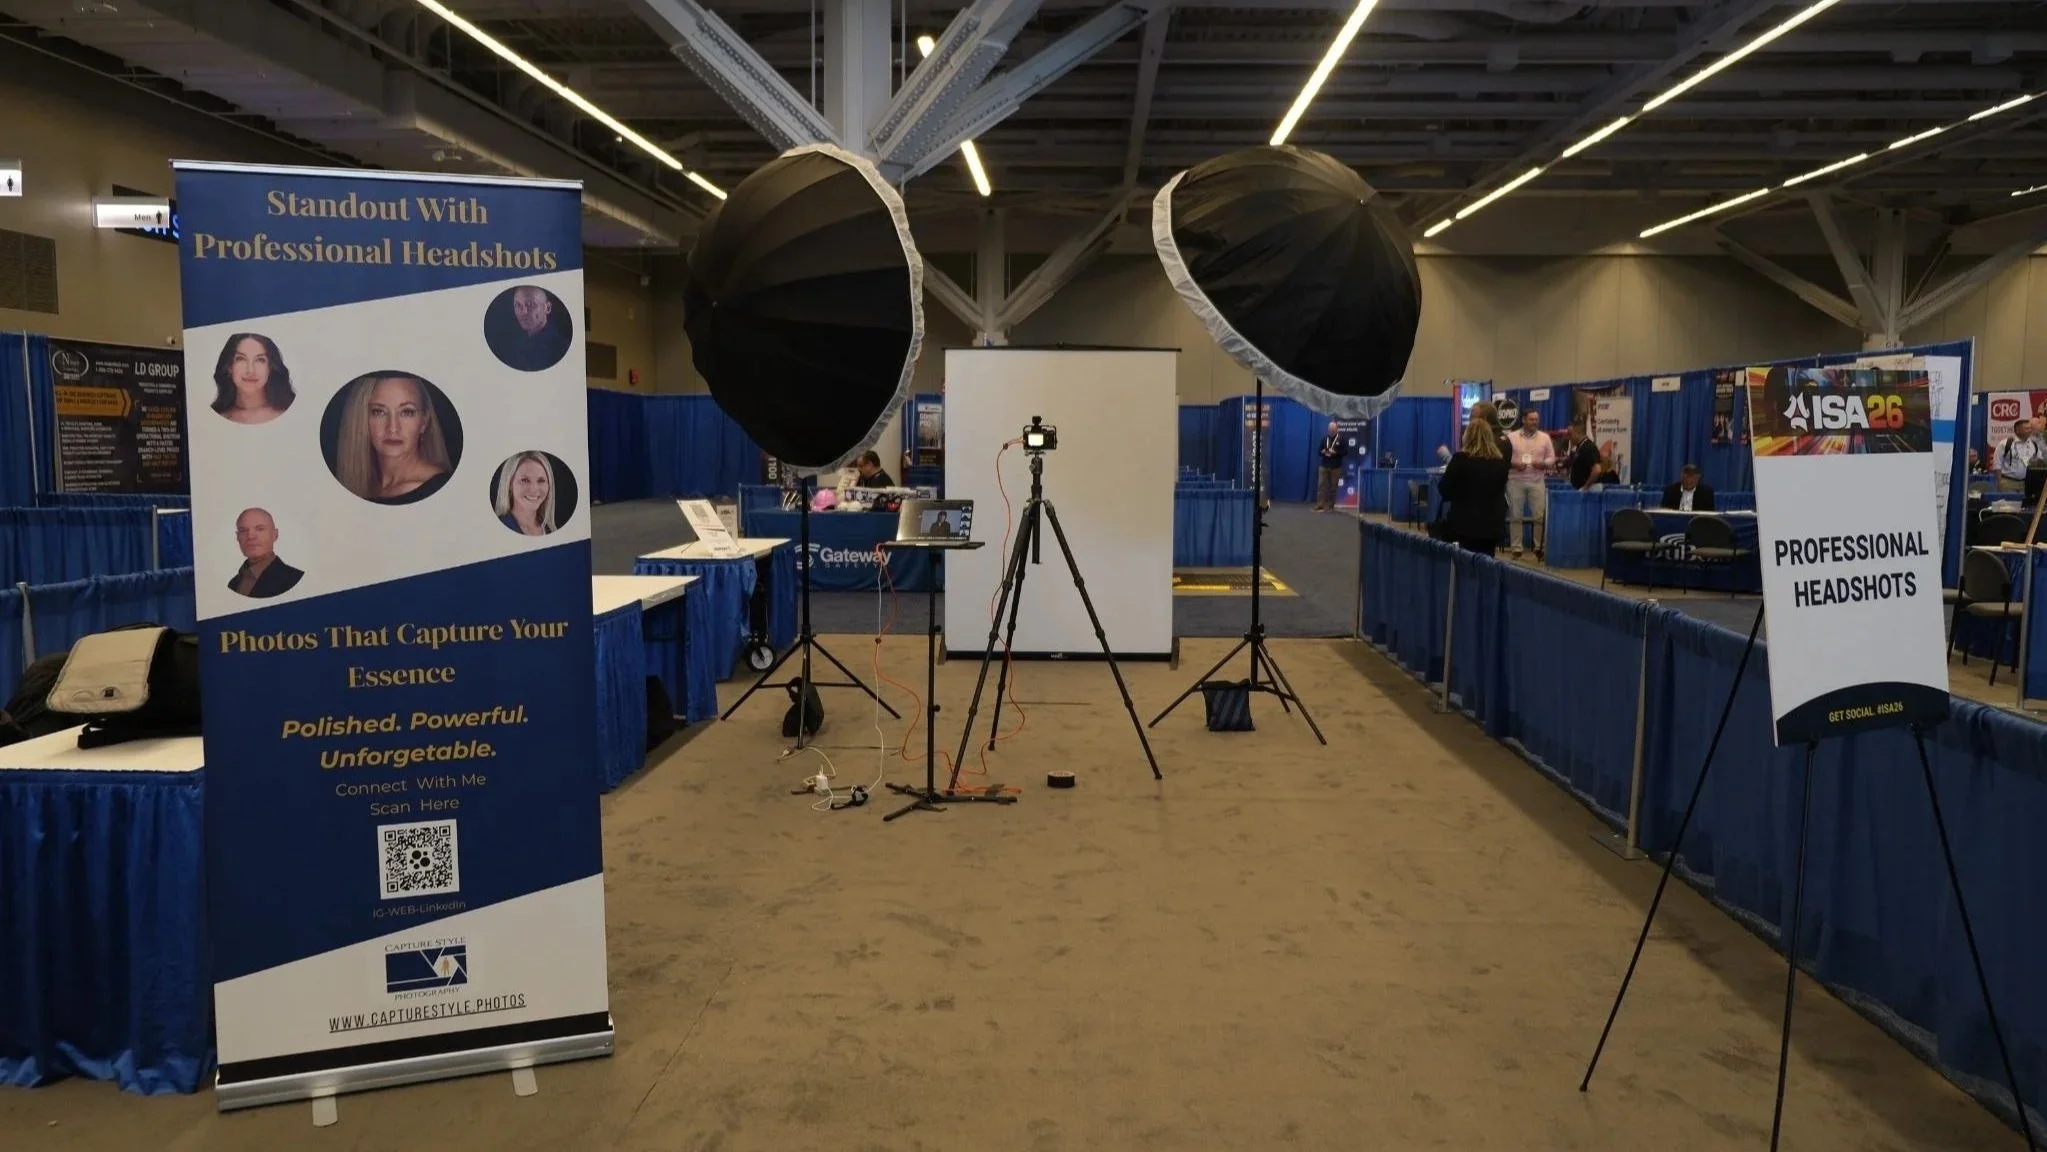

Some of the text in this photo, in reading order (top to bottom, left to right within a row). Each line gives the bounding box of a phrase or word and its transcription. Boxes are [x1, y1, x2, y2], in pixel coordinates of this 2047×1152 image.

[134, 213, 151, 221] Men
[267, 190, 488, 224] Standout With
[193, 232, 557, 270] Professional Headshots
[148, 363, 180, 377] GROUP
[1811, 394, 1904, 430] ISA26
[1992, 402, 2019, 417] CRC
[820, 547, 892, 566] Gateway
[1775, 531, 1929, 566] PROFESSIONAL
[1794, 571, 1917, 607] HEADSHOTS
[220, 618, 569, 653] Photos That Capture Your
[347, 665, 456, 689] Essence
[282, 704, 529, 739] Polished. Powerful.
[1828, 710, 1845, 722] GET
[1877, 701, 1904, 715] #ISA26
[320, 739, 497, 769] Unforgetable.
[335, 773, 487, 797] Connect With Me
[370, 798, 460, 816] Scan Here
[384, 936, 467, 952] CAPTURE STYLE
[394, 987, 461, 1001] PHOTOGRAPHY
[329, 993, 527, 1033] WWW.CAPTURESTYLE.PHOTOS
